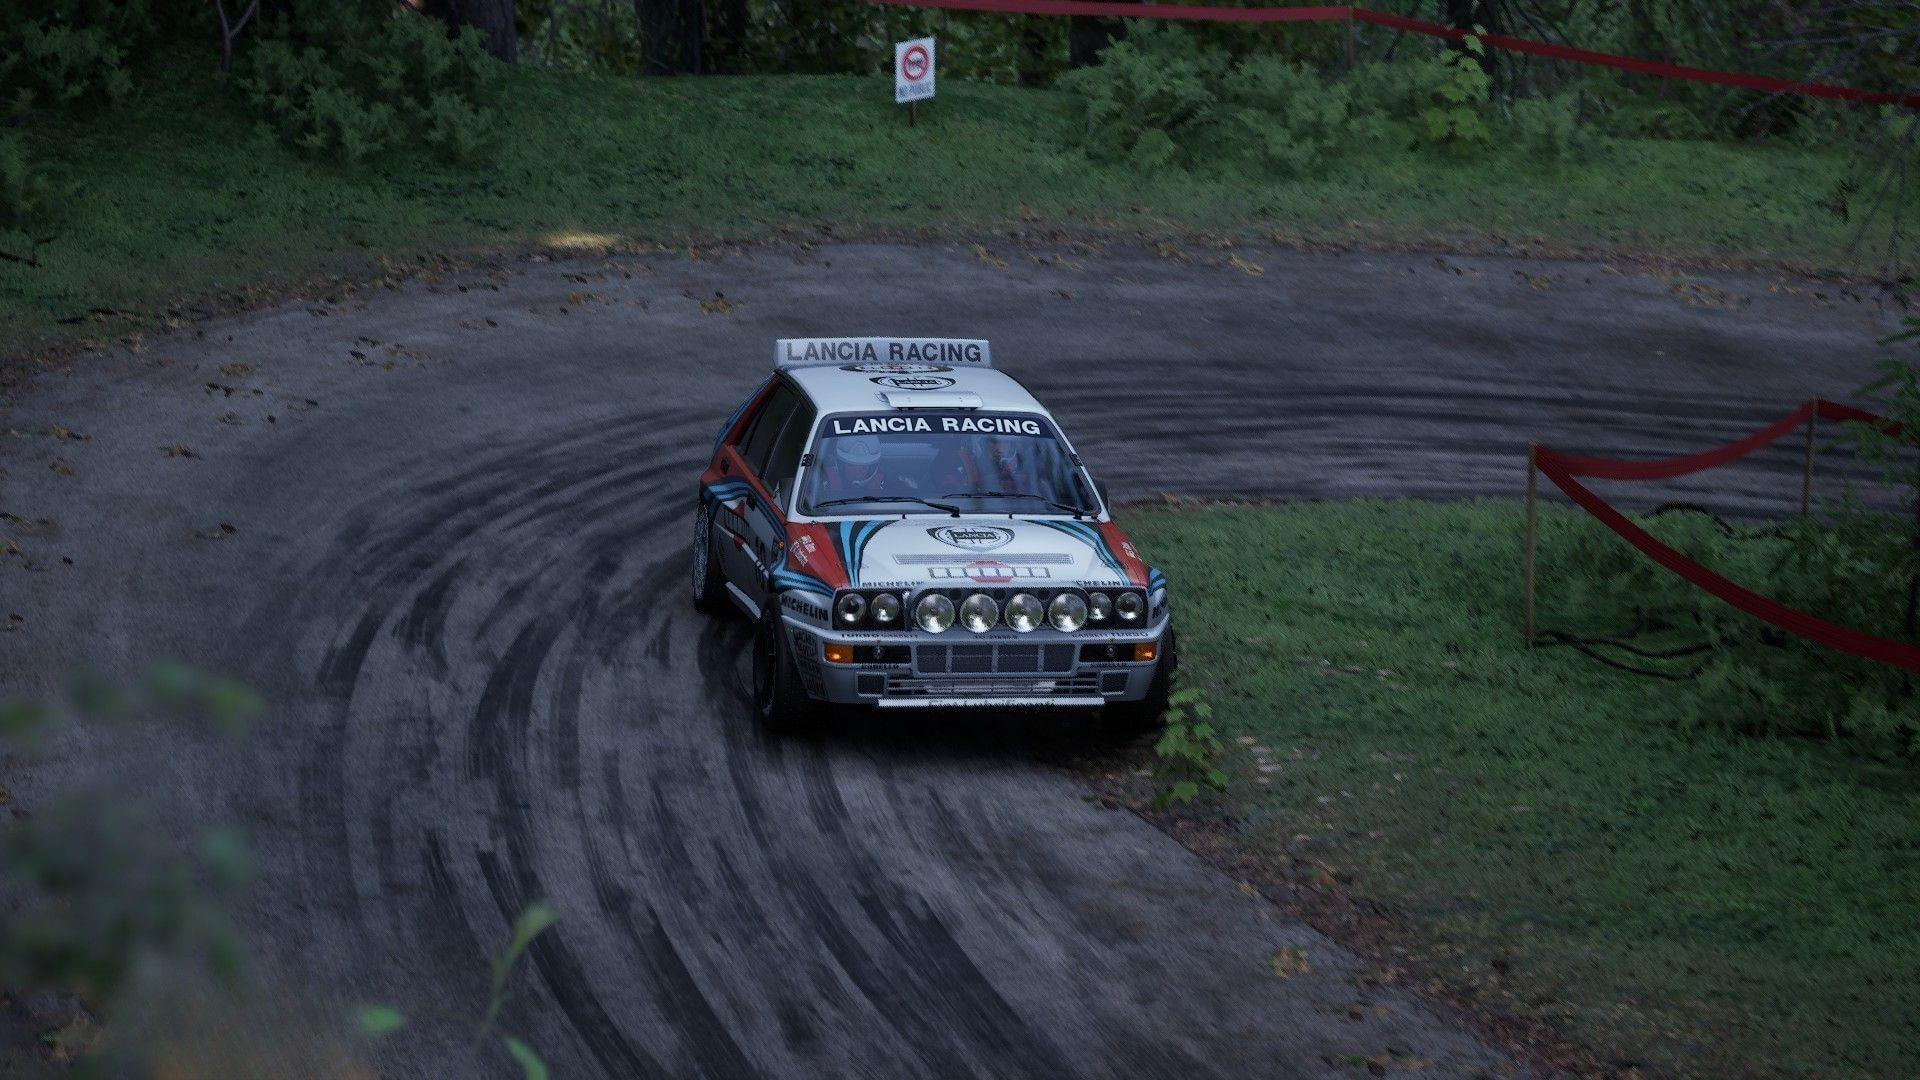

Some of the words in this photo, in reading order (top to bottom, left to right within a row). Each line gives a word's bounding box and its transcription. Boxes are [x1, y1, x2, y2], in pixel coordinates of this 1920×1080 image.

[787, 342, 878, 362] LANCIA
[888, 343, 982, 363] RACING
[833, 417, 932, 435] LANCIA
[942, 417, 1041, 435] RACING
[781, 595, 830, 622] MICHELIN
